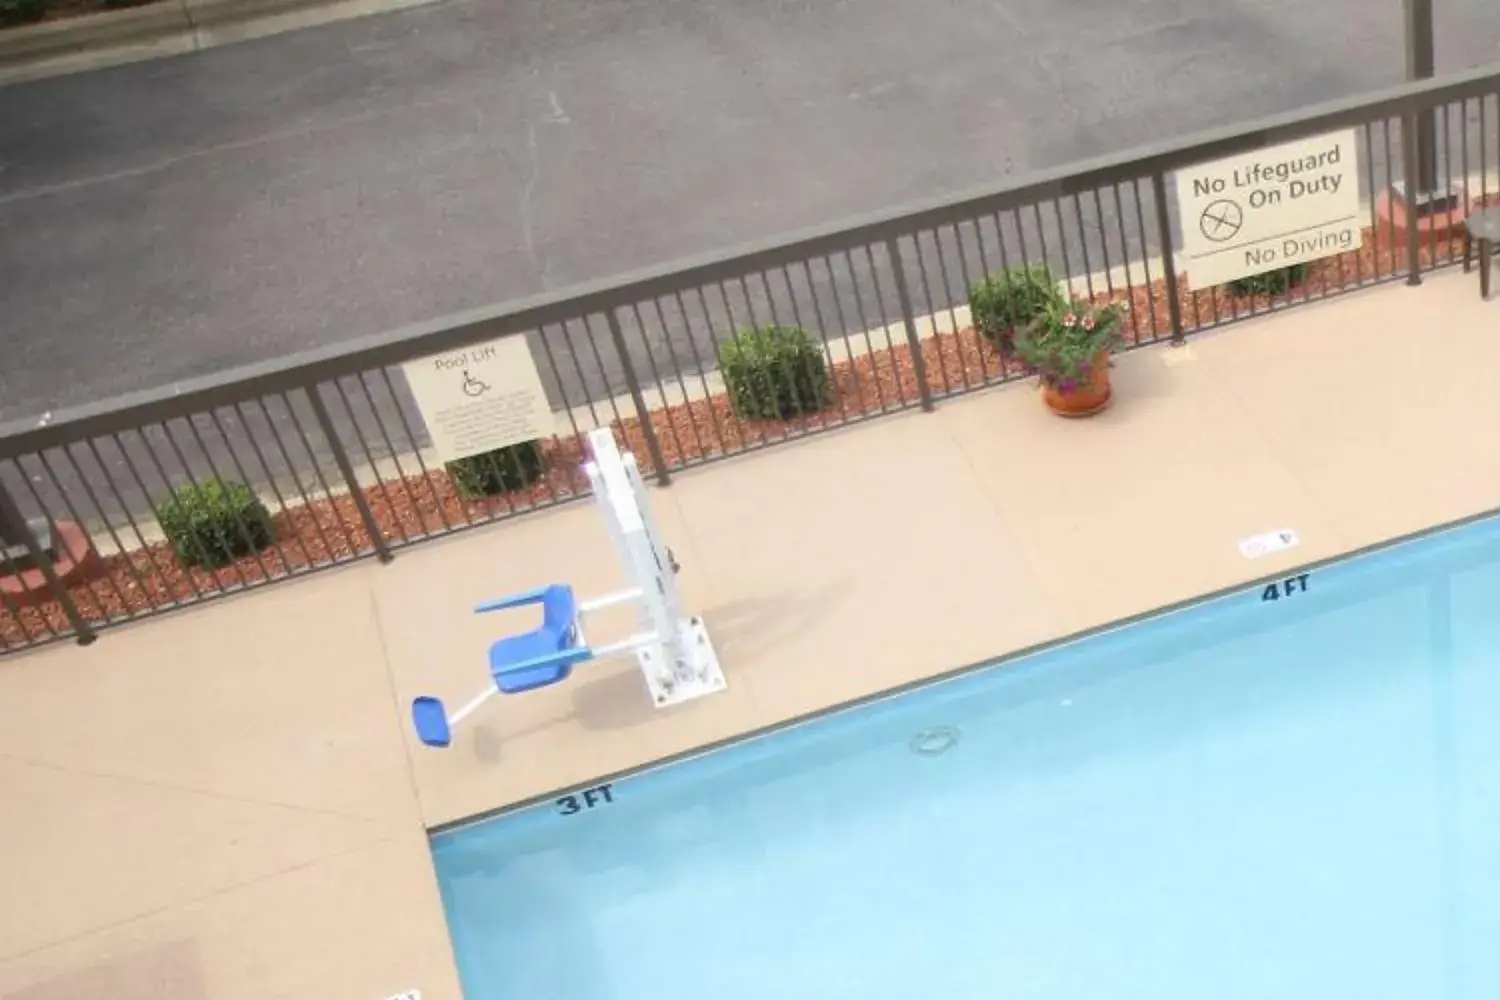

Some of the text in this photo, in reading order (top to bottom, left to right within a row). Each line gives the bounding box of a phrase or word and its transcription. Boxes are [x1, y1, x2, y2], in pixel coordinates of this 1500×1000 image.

[1193, 144, 1341, 198] No Lifeguard
[1249, 174, 1342, 209] On Duty
[1245, 229, 1352, 267] No Diving
[434, 346, 496, 370] Pool Lift
[1262, 573, 1310, 602] 4 FT
[556, 784, 613, 815] 3 FT
